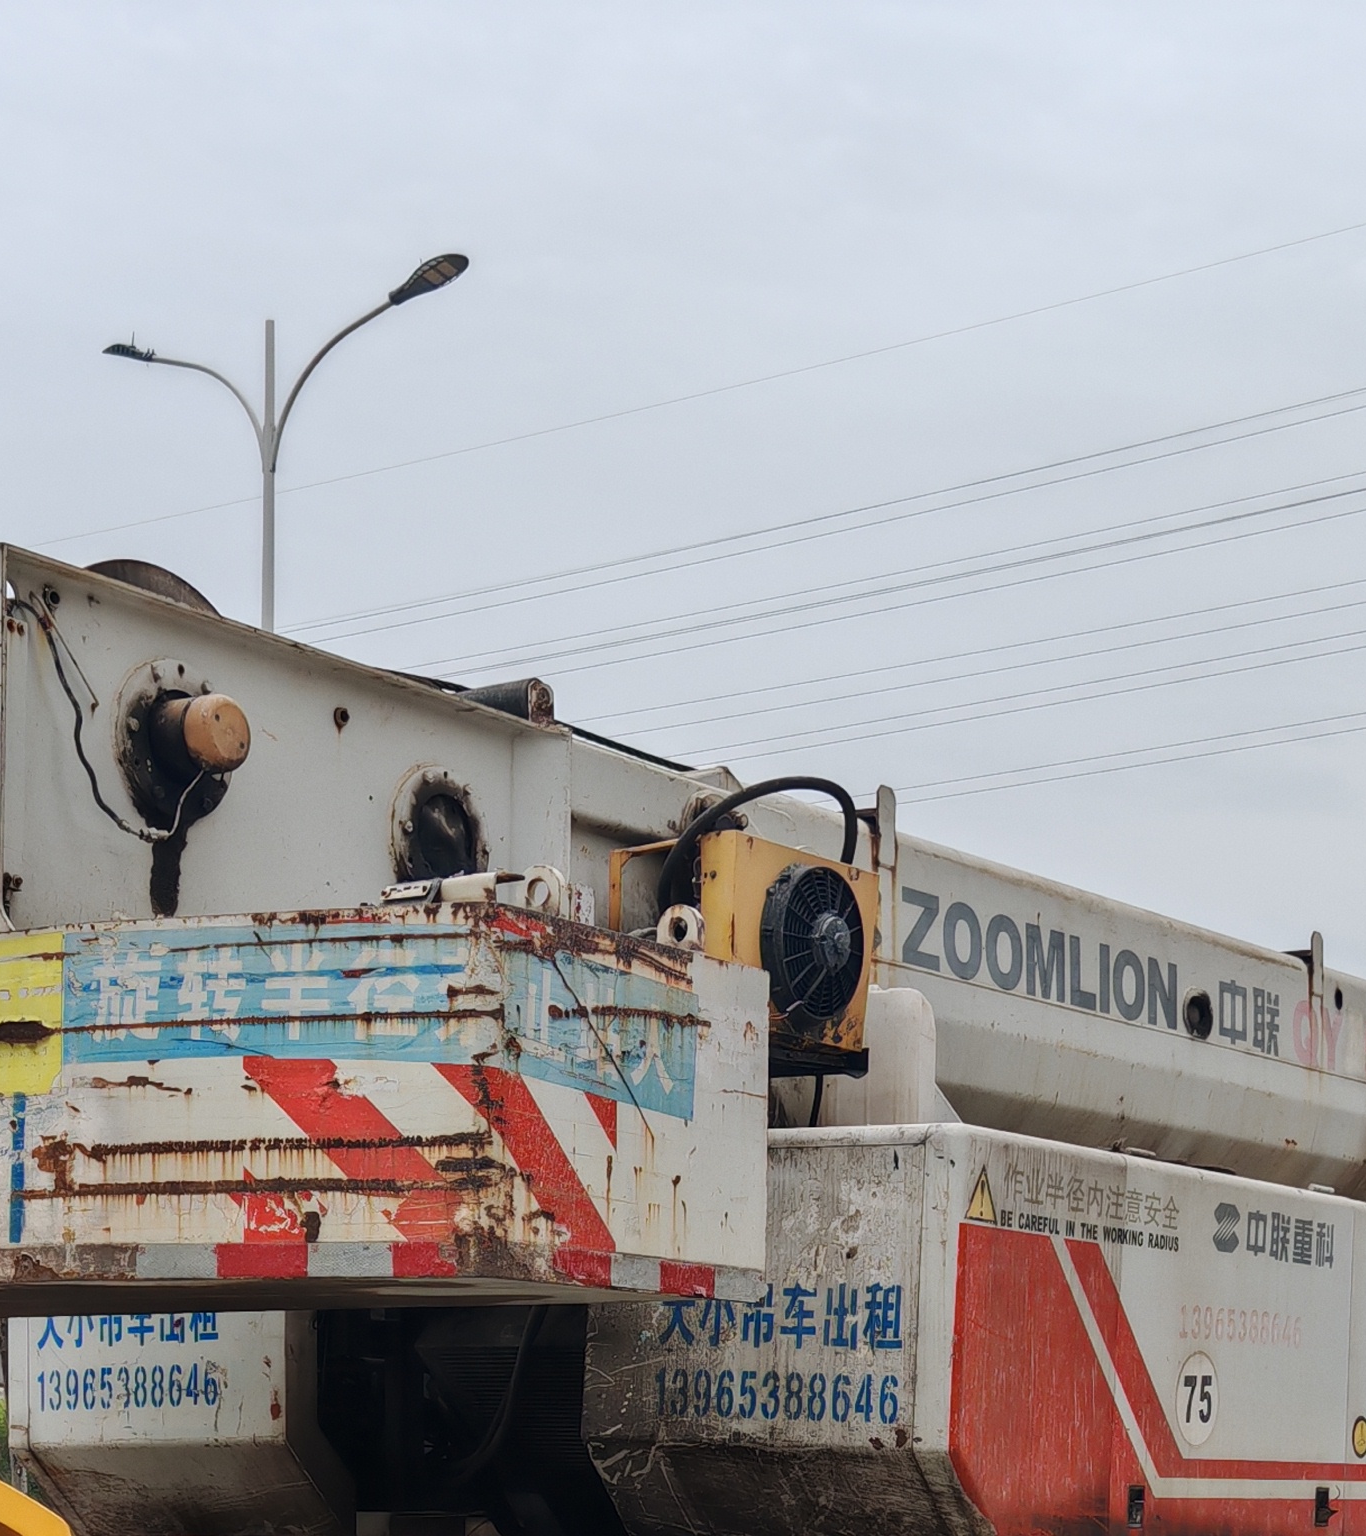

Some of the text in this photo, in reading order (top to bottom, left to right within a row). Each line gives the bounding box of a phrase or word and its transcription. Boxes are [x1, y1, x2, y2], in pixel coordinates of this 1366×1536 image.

[902, 886, 1178, 1031] ZOOMLION
[1219, 980, 1280, 1057] 中联
[1003, 1166, 1180, 1231] 作业半径内注意安全
[1000, 1209, 1179, 1252] BE CAREFUL IN THE WORKING RADIUS
[1246, 1210, 1334, 1269] 中联重科
[658, 1282, 902, 1350] 大小吊车出租
[37, 1363, 219, 1412] 13965388646
[655, 1366, 899, 1424] 13965388646
[1183, 1374, 1213, 1424] 75
